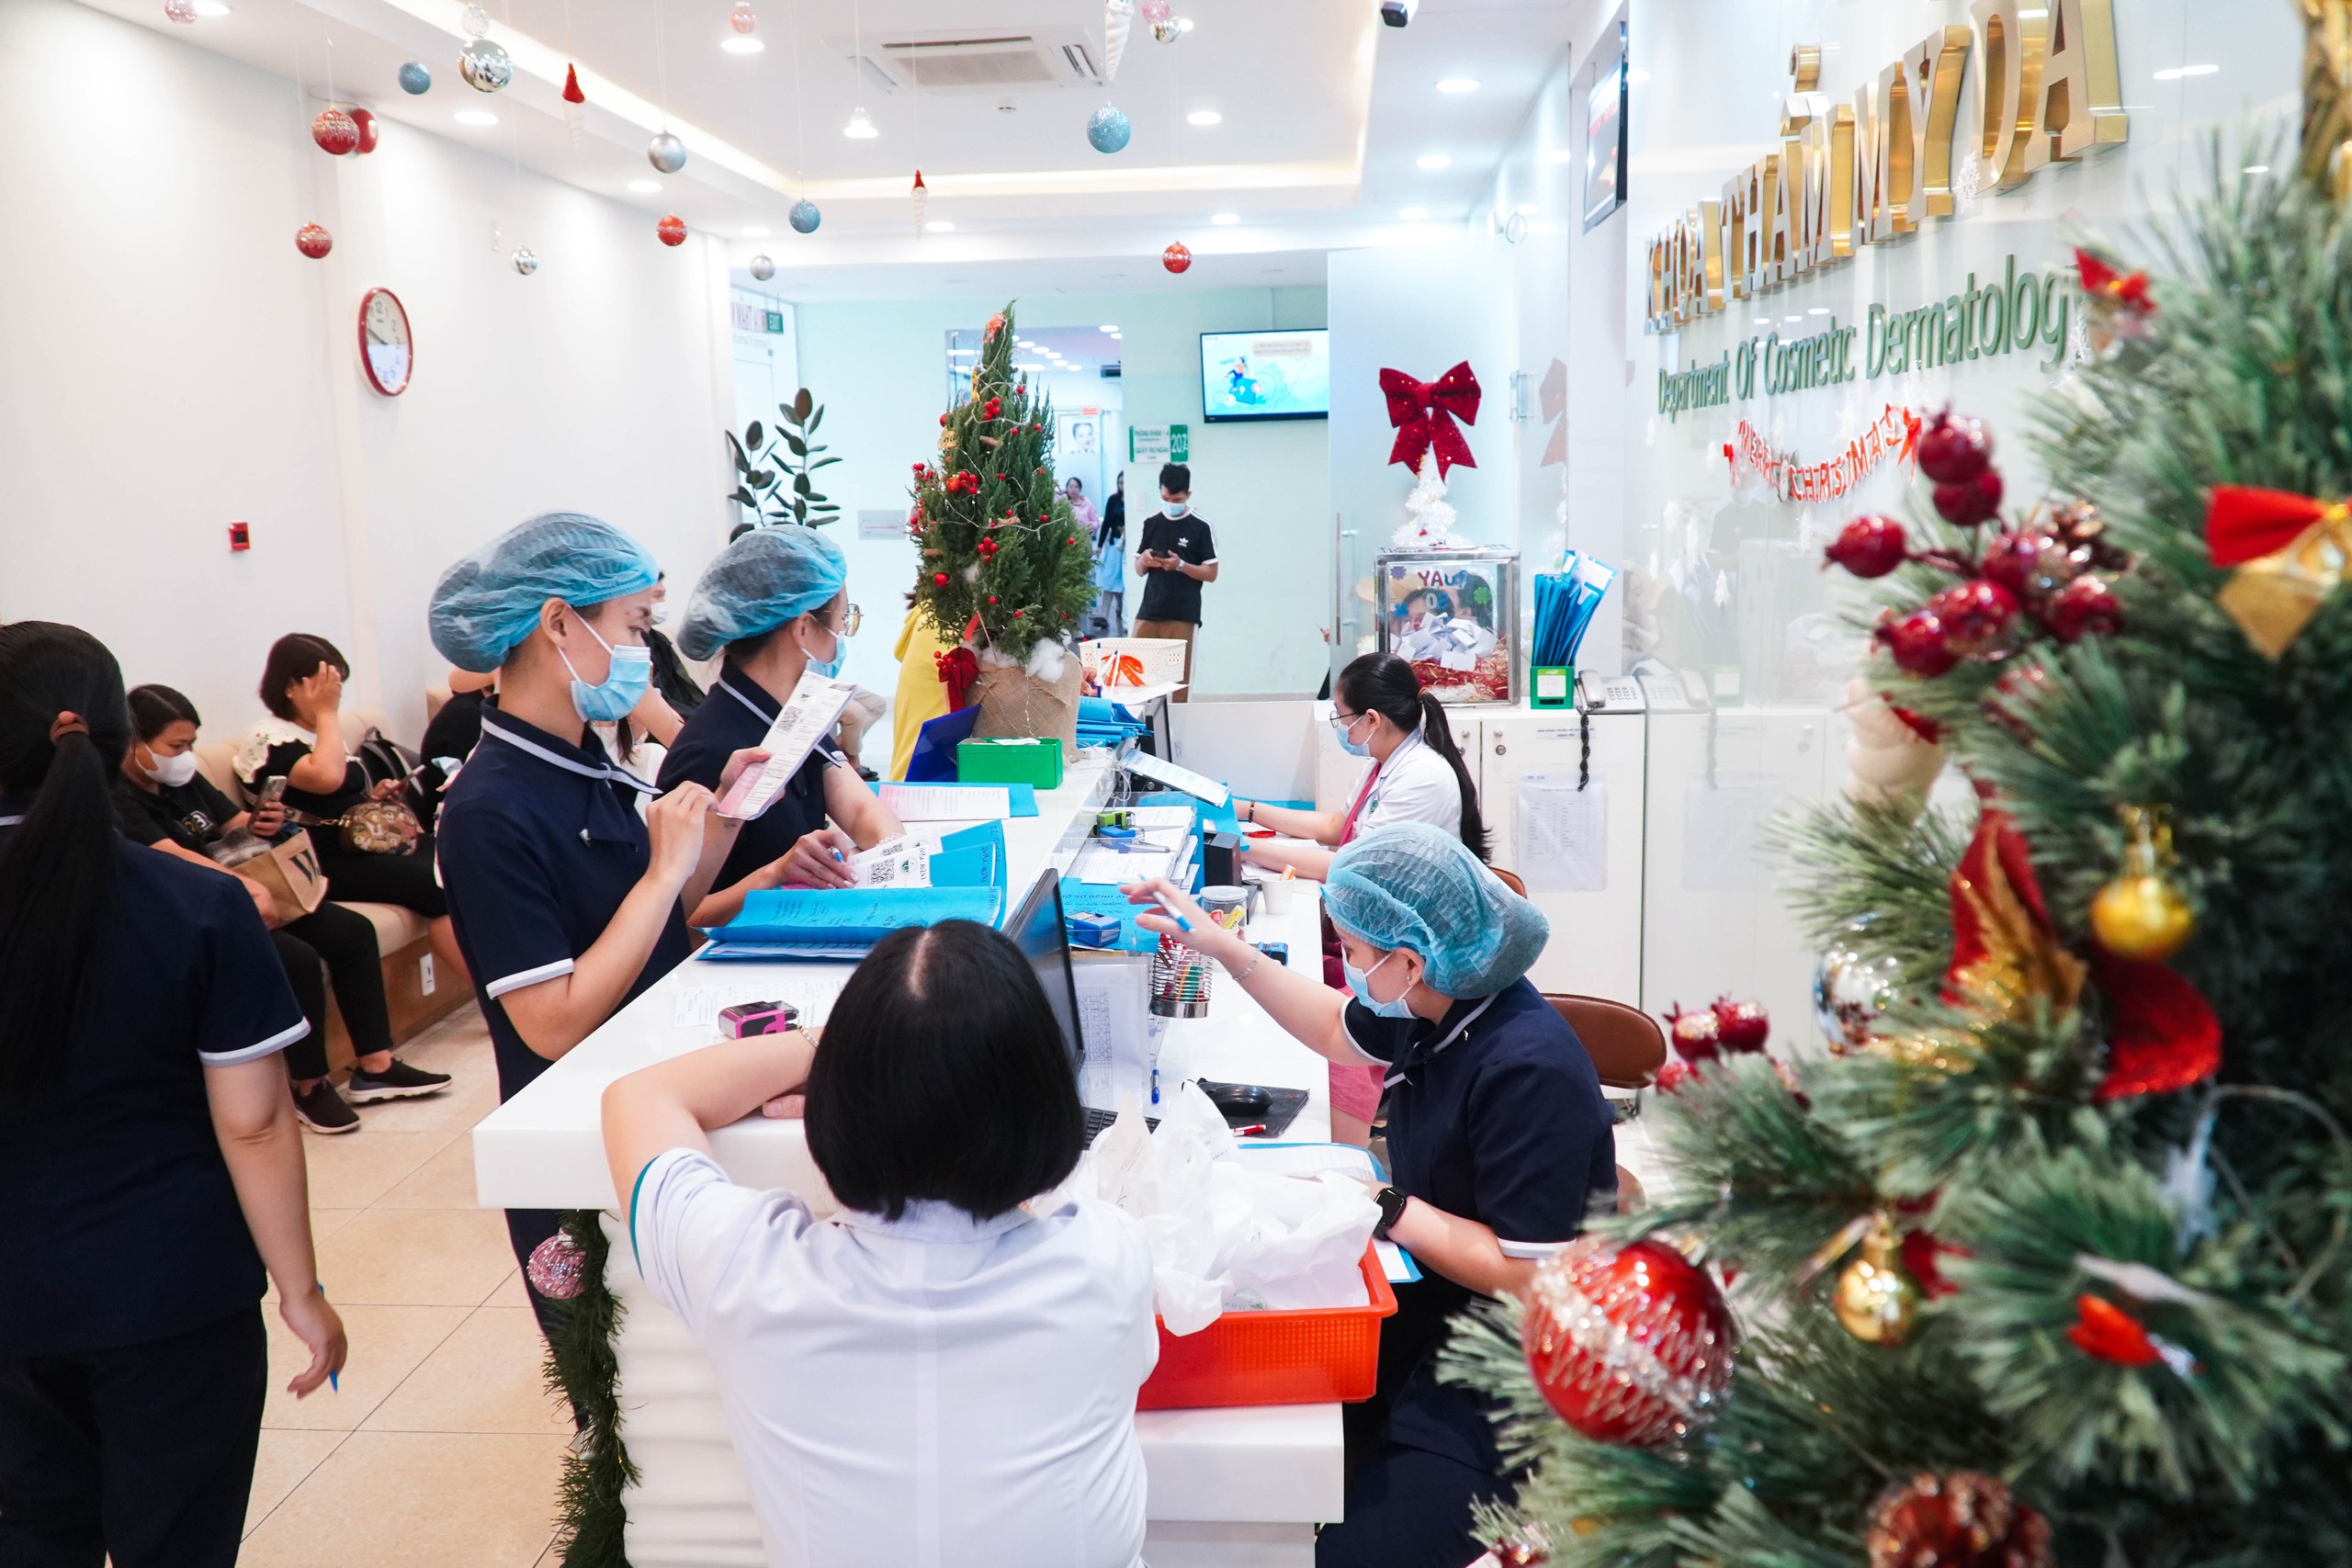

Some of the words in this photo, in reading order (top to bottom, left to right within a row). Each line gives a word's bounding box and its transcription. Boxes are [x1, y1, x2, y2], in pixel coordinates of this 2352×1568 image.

[1645, 198, 1725, 336] KHOA
[1966, 0, 2128, 199] DA
[1657, 347, 1731, 424] Department
[1736, 334, 1759, 400] Of
[1763, 314, 1858, 397] Cosmetic
[1866, 254, 2069, 380] Dermatolog
